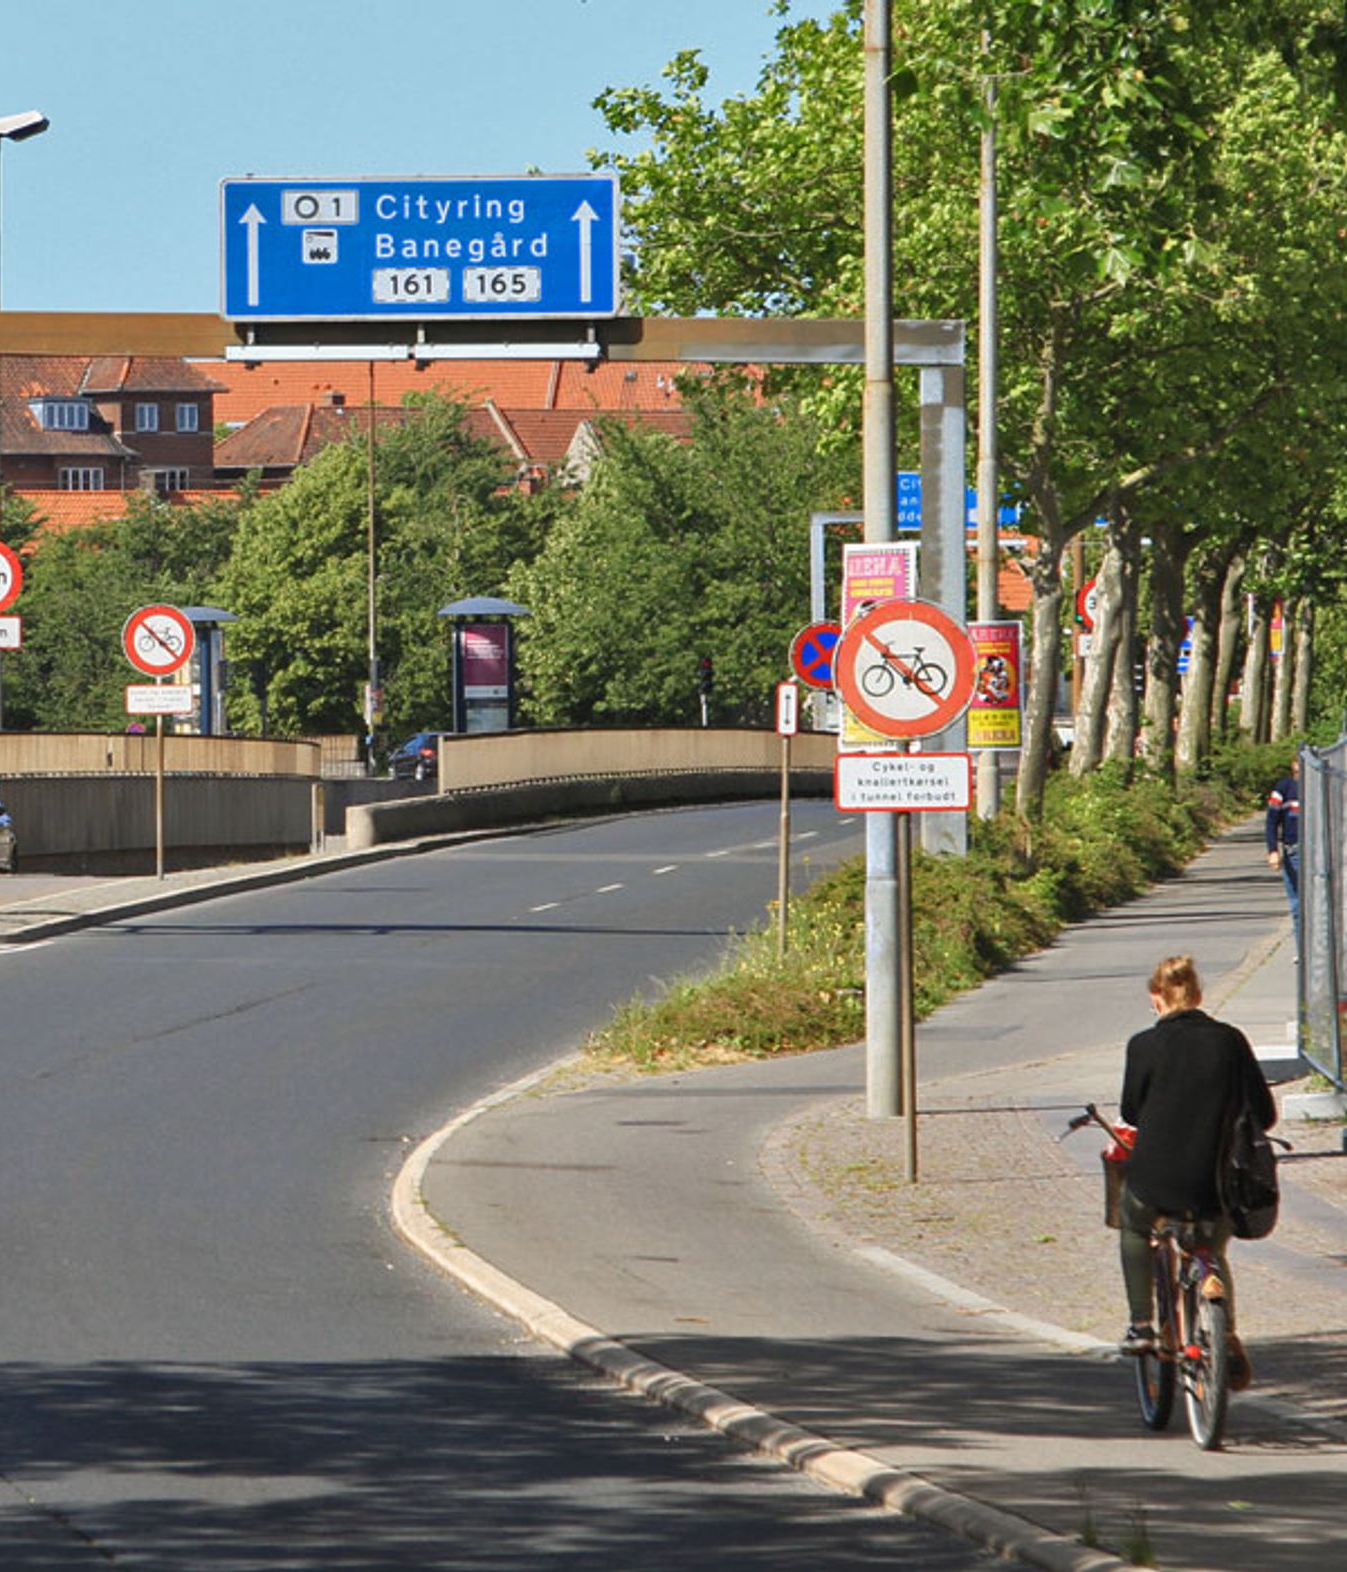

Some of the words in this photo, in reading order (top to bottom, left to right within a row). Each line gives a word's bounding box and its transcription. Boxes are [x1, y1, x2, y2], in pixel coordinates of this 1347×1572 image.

[375, 194, 525, 224] Cityring
[375, 232, 548, 263] Banegård
[390, 274, 433, 295] 161
[477, 273, 527, 294] 165
[920, 763, 935, 773] og
[860, 792, 901, 801] tunnel
[906, 792, 956, 801] forbudt
